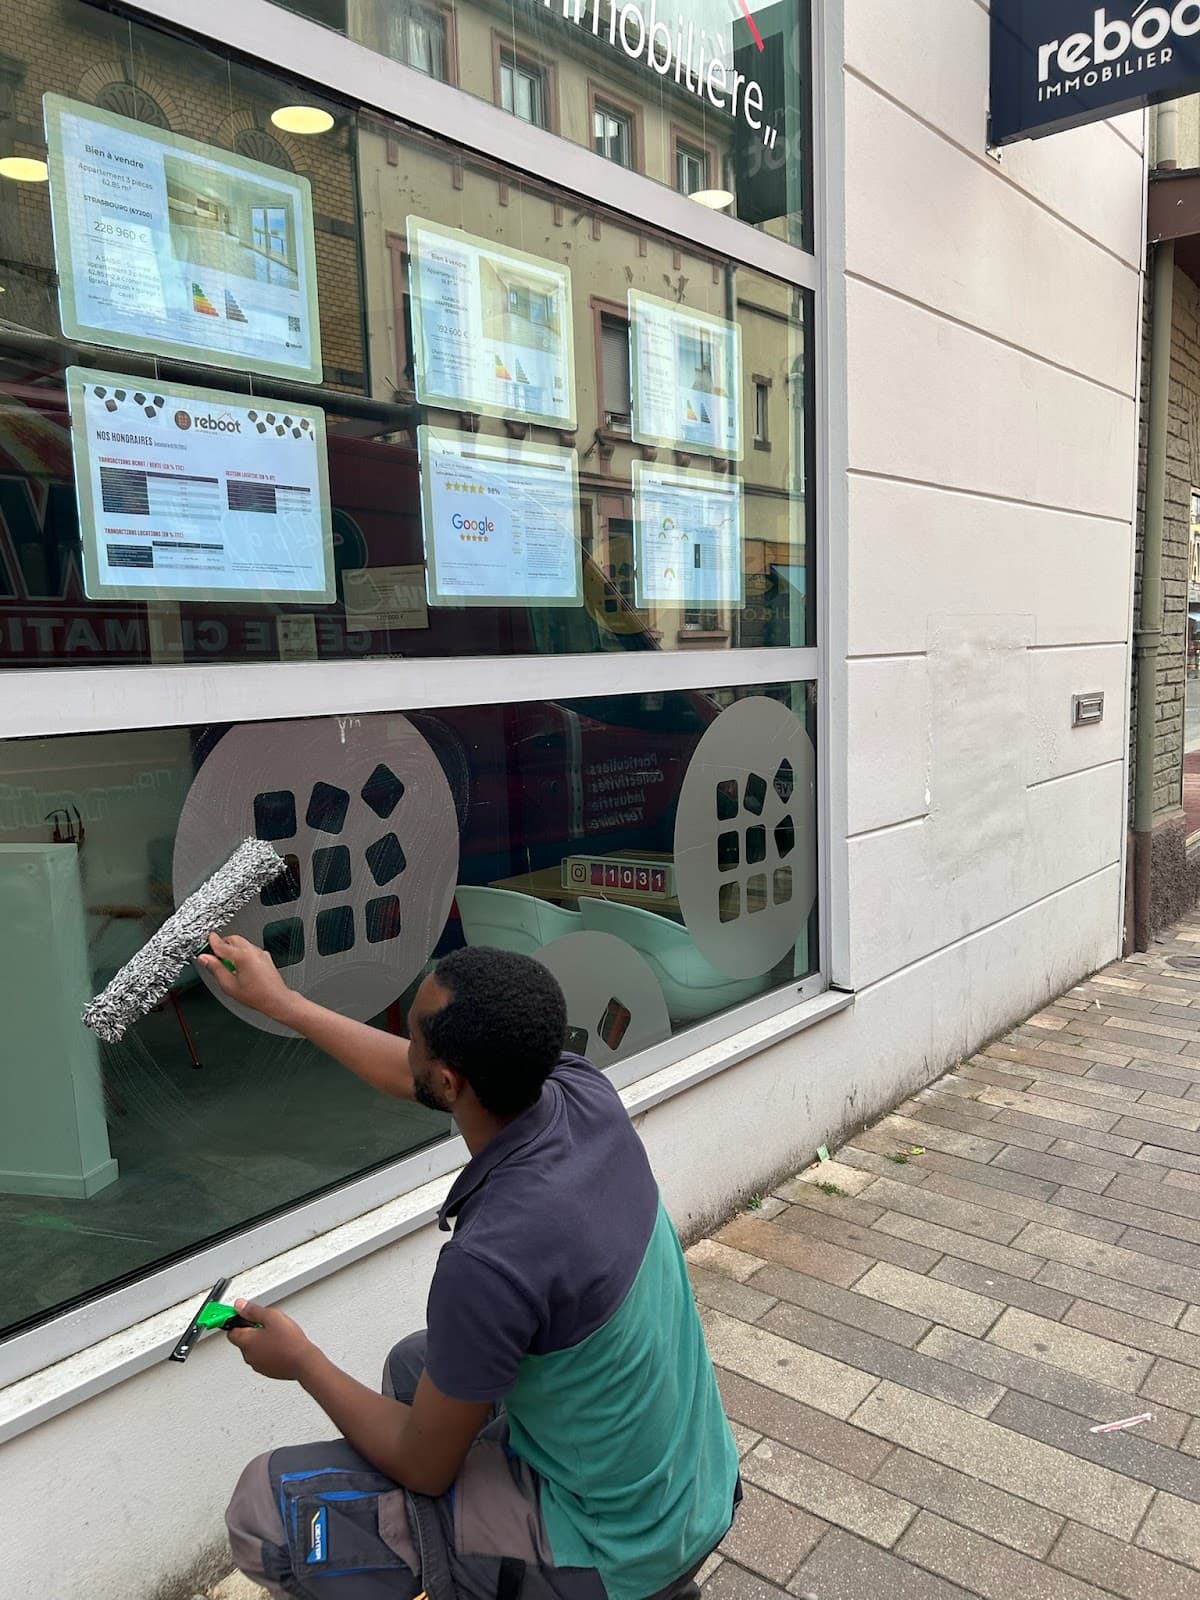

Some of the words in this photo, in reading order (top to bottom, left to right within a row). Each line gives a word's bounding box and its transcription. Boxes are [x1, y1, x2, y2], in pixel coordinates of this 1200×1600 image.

[1038, 48, 1173, 102] IMMOBILIER
[85, 144, 105, 157] Bien
[107, 151, 112, 160] à
[114, 155, 144, 169] vendre
[79, 162, 125, 181] Appartement
[84, 195, 128, 212] STRASBOURG
[93, 221, 113, 234] 228
[116, 227, 136, 240] 960
[194, 413, 241, 434] reboot
[96, 430, 110, 441] NOS
[112, 432, 153, 446] HONORAIRES
[452, 513, 494, 535] Google
[609, 869, 662, 887] 1031
